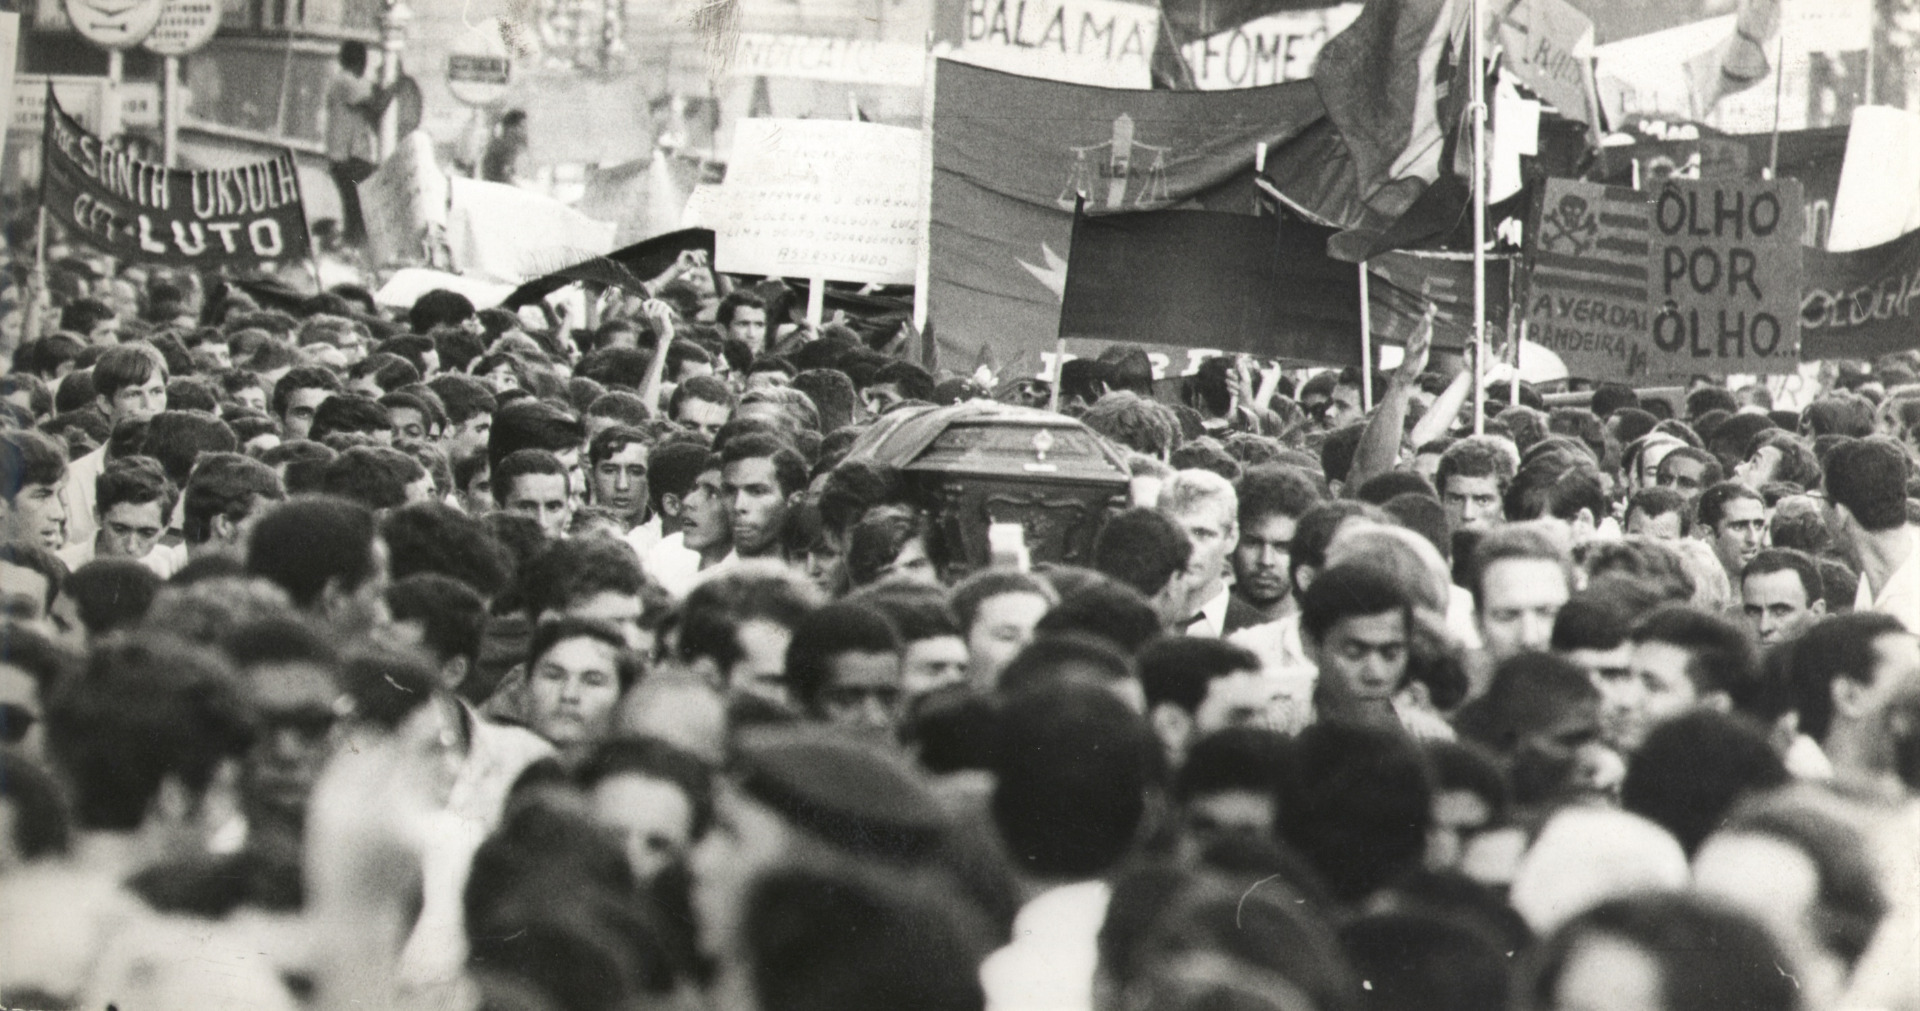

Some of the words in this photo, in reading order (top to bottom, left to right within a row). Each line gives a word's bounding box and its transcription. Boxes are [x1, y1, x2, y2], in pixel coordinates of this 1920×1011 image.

[192, 151, 299, 219] URSULA
[1656, 177, 1780, 240] ÔLHO
[138, 214, 284, 257] LUTO
[776, 246, 889, 267] ASSASSINADO
[1662, 246, 1763, 299] POR
